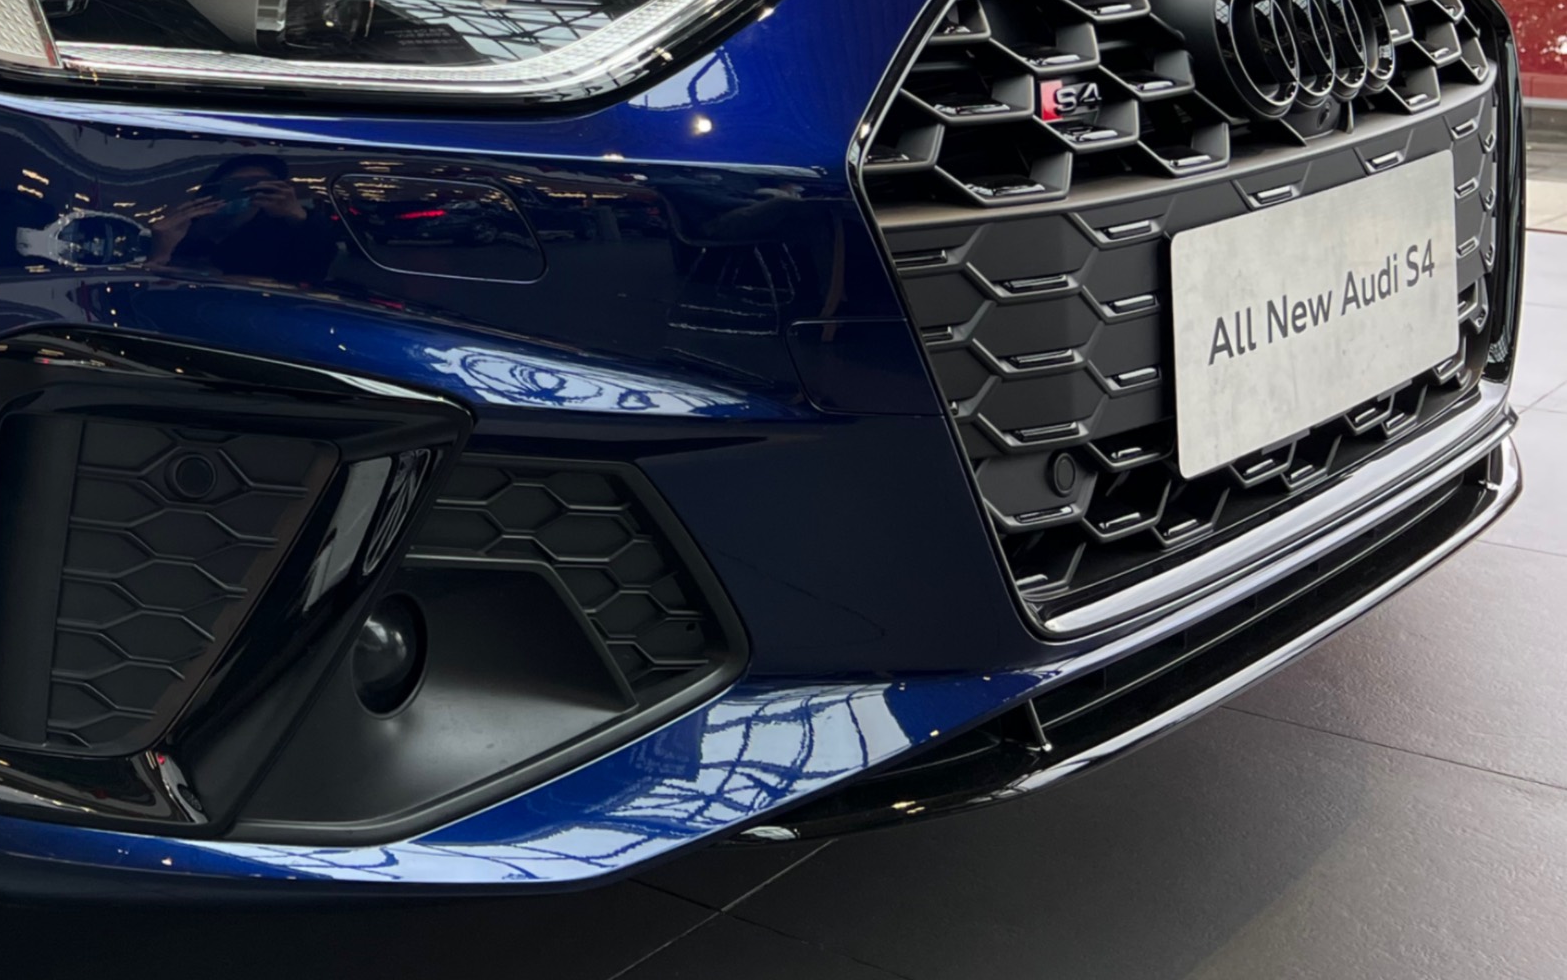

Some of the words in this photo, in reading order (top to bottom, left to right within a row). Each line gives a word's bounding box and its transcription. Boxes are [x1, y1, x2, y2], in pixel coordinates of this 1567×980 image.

[1055, 82, 1102, 112] S4
[1208, 307, 1257, 366] All
[1267, 290, 1332, 344] New
[1341, 253, 1399, 316] Audi
[1405, 238, 1436, 288] S4
